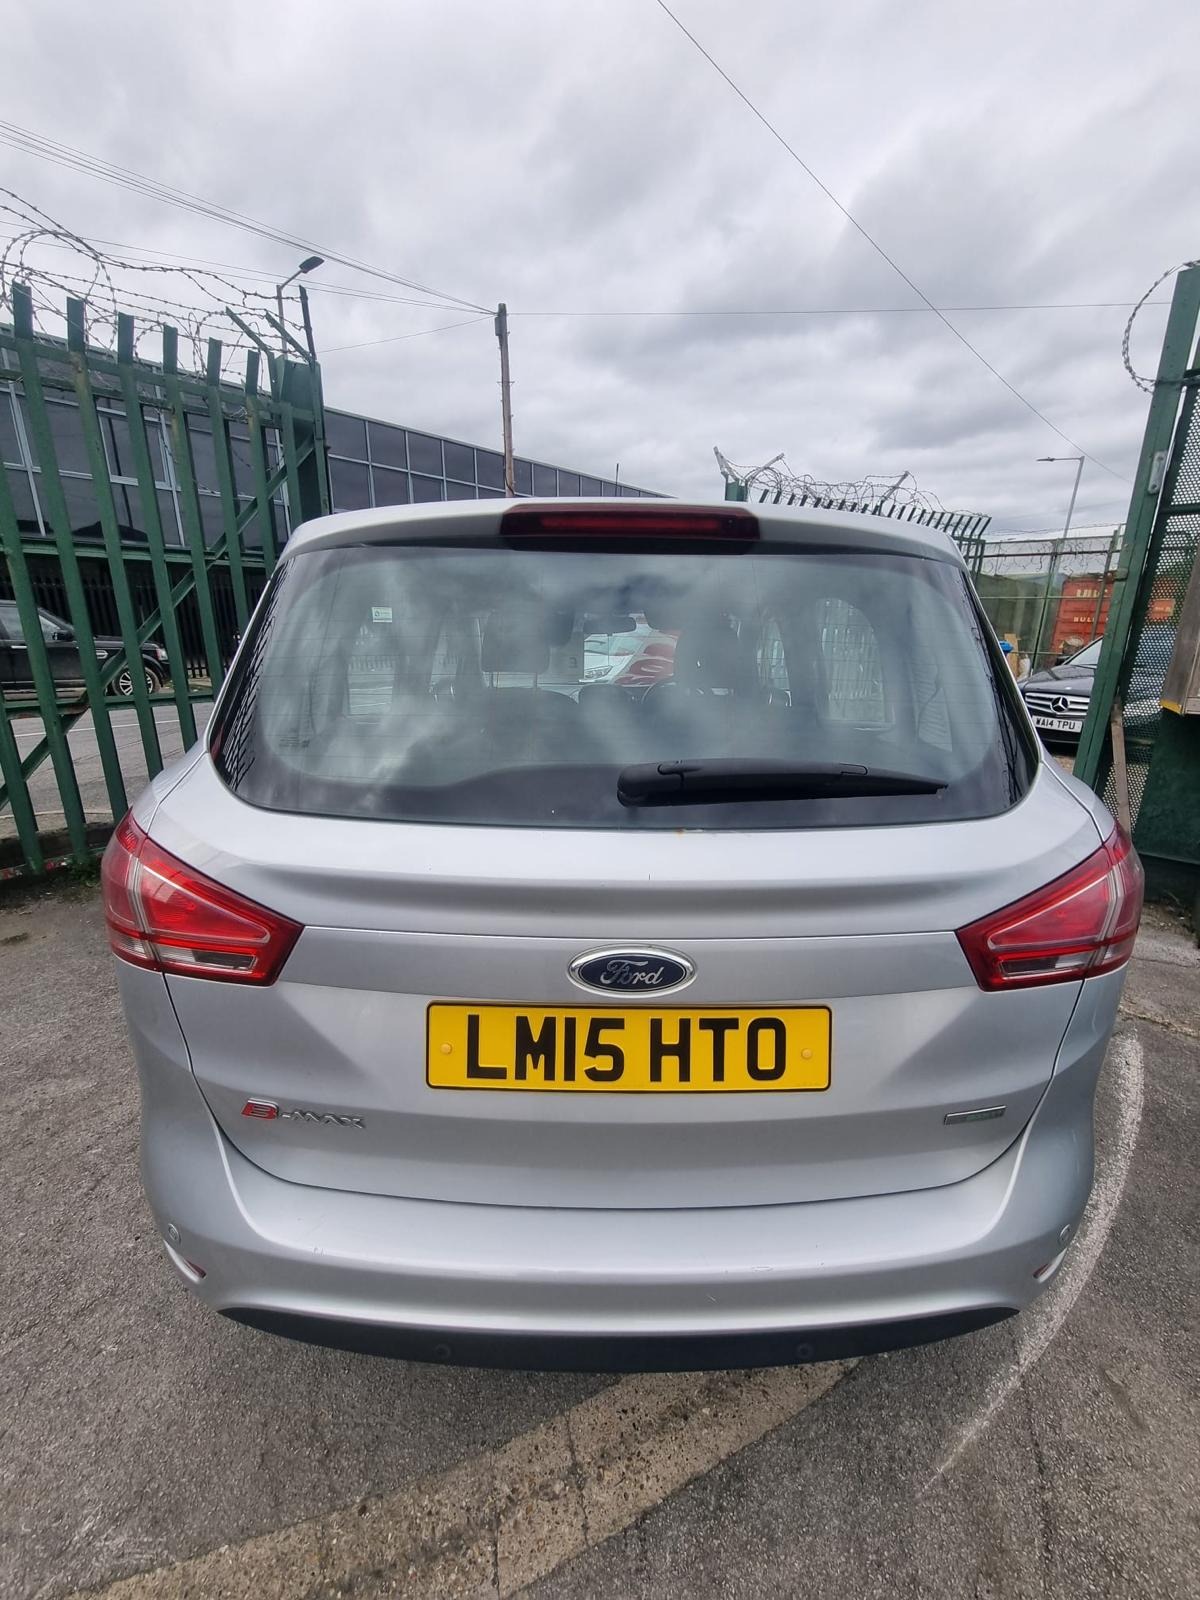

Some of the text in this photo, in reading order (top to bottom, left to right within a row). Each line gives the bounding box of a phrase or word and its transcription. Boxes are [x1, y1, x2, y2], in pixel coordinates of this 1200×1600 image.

[1036, 717, 1076, 730] WA14 TPU
[600, 959, 665, 985] Ford
[466, 1014, 787, 1082] LM15 HTO
